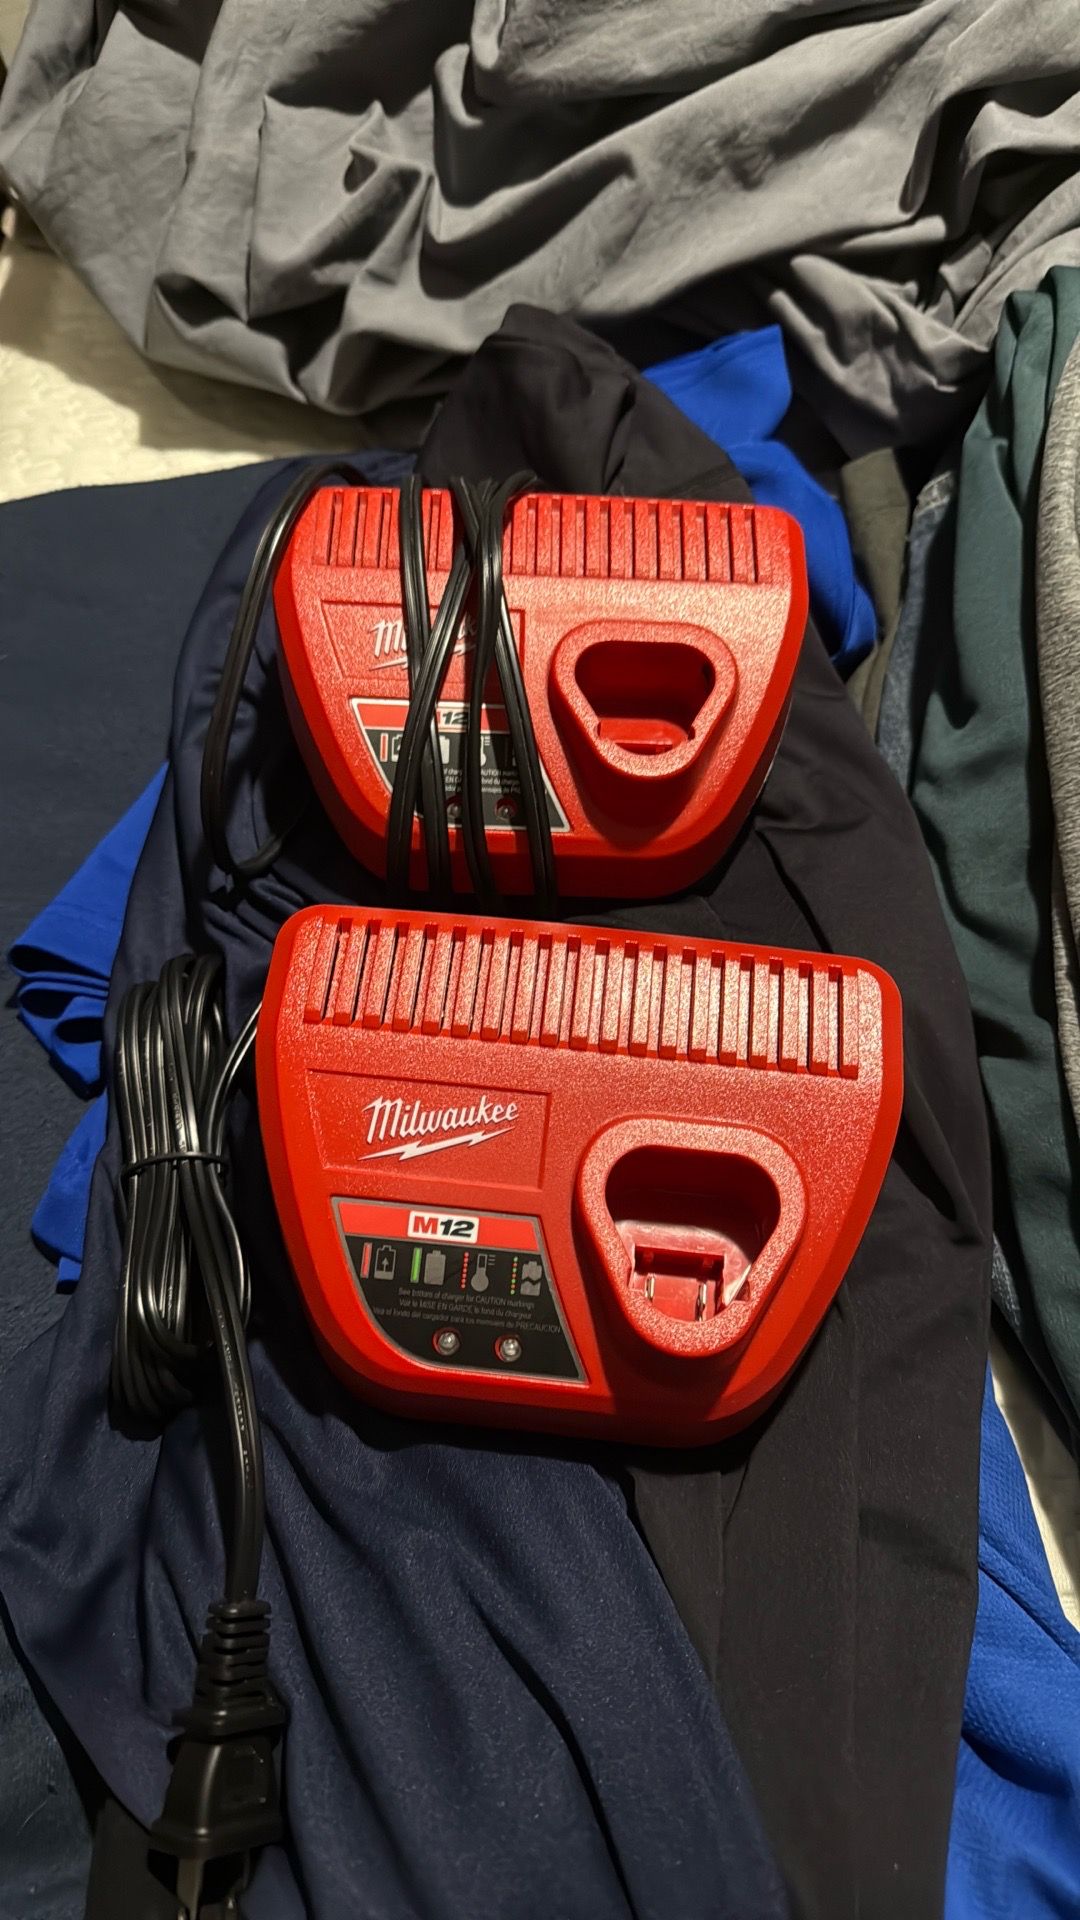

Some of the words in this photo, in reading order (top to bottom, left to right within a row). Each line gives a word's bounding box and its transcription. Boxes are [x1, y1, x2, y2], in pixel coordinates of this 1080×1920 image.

[362, 1095, 519, 1144] Milwaukee
[413, 1215, 475, 1238] M12
[437, 1302, 447, 1310] EN
[495, 1308, 504, 1317] du
[475, 1296, 506, 1306] CAUTION
